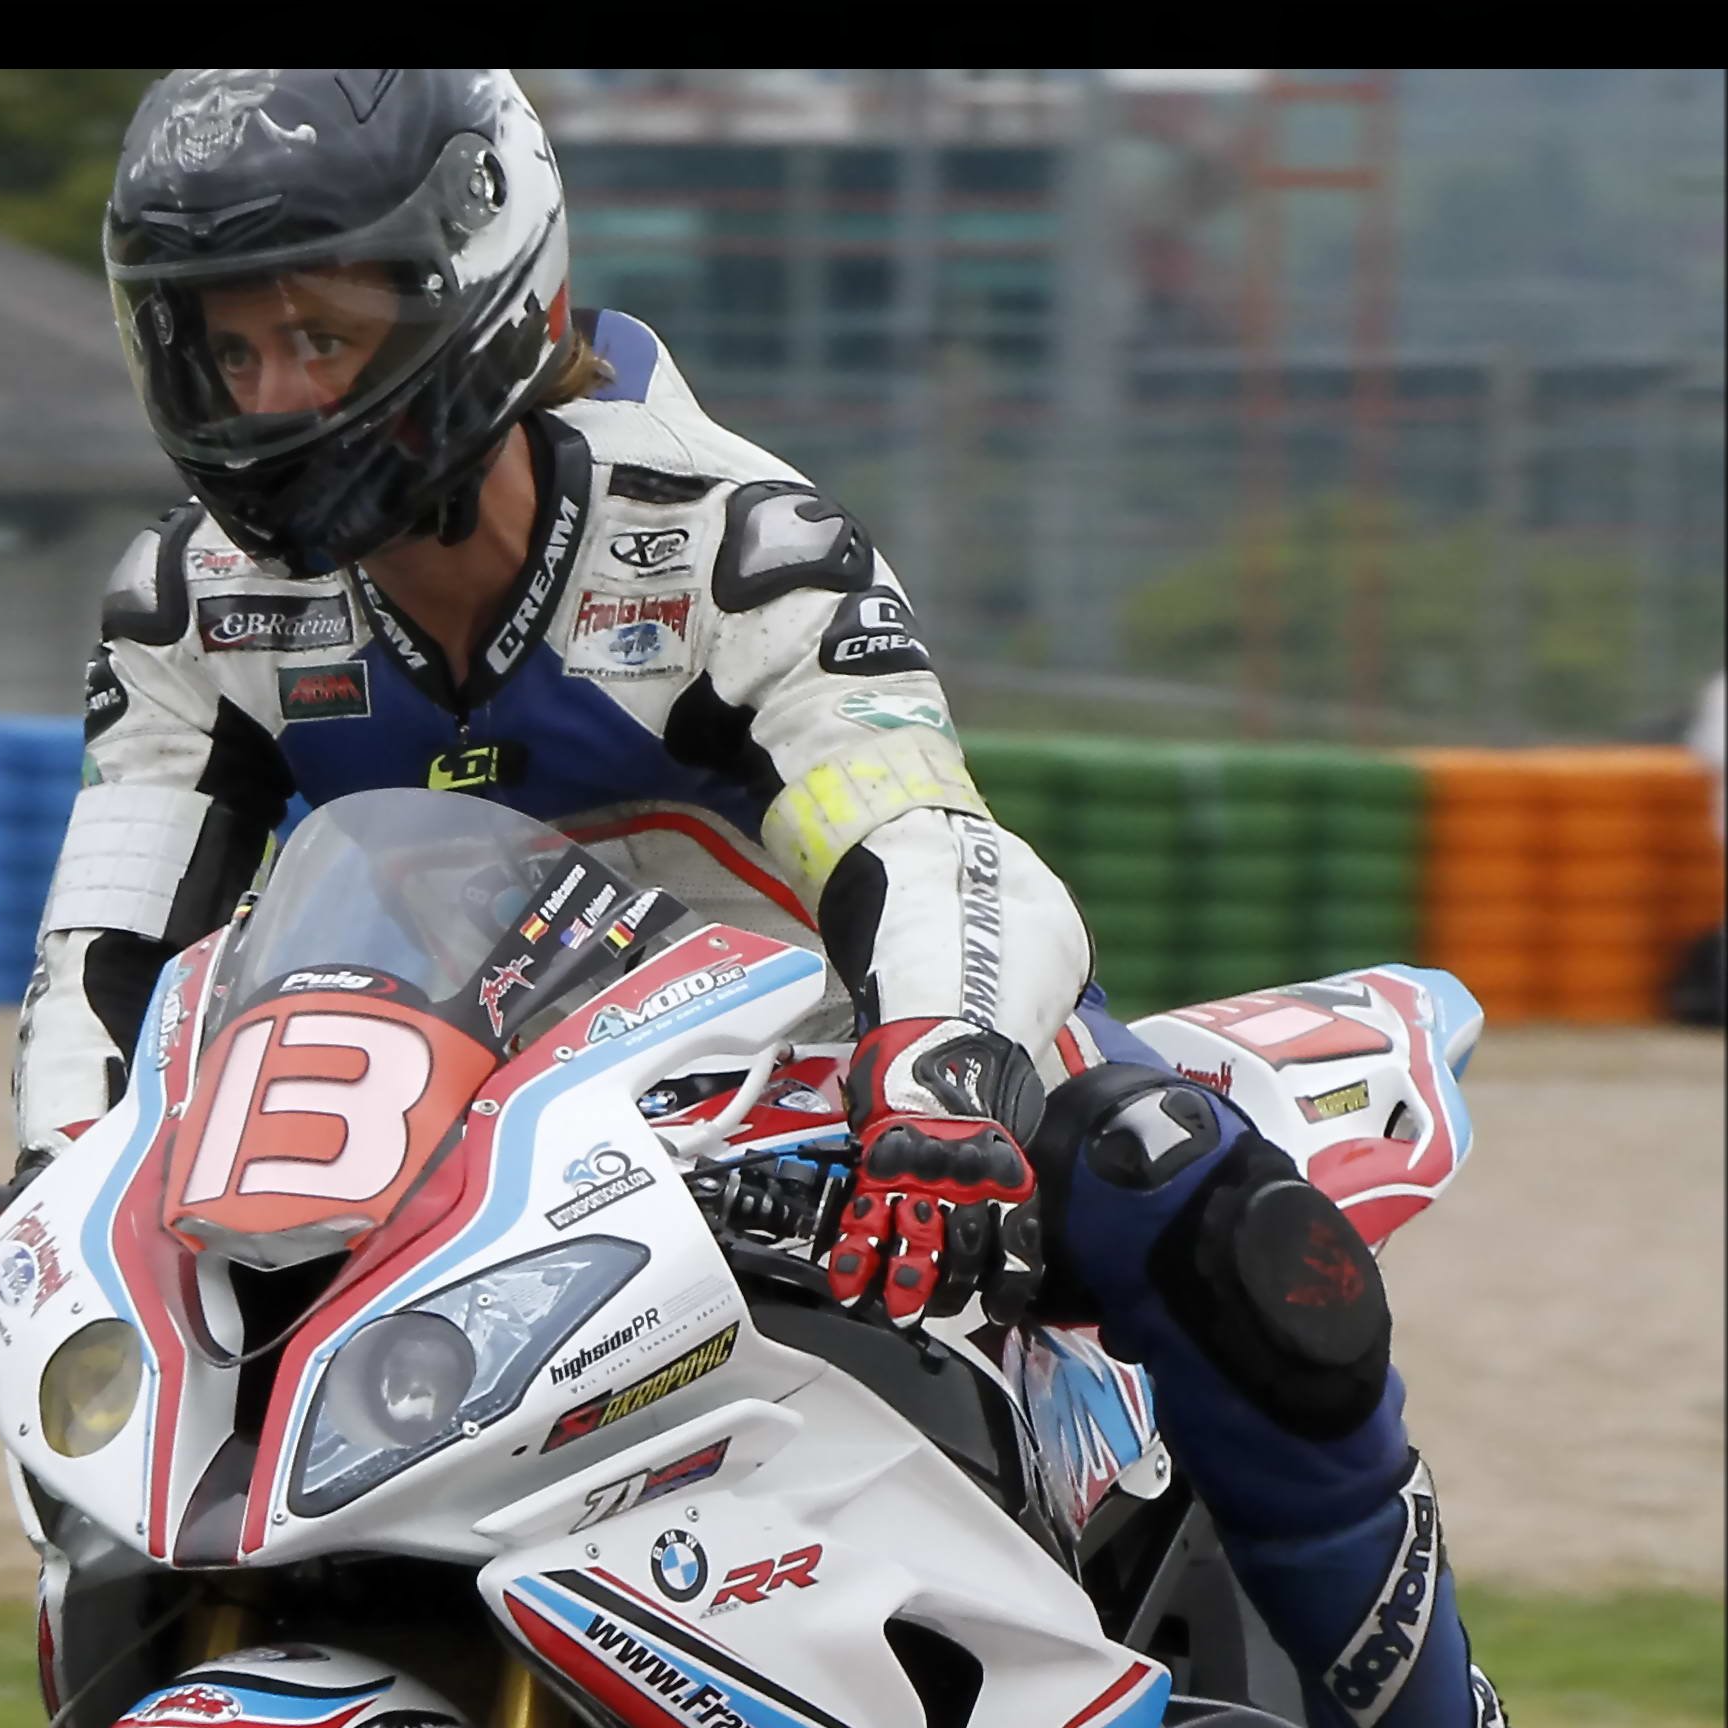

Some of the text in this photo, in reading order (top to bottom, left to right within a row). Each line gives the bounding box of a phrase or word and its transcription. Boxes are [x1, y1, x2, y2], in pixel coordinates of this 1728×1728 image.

[222, 612, 346, 639] GBRacing
[282, 970, 375, 990] Puig
[181, 1009, 434, 1204] 13
[550, 1307, 662, 1386] highsidePR
[710, 1543, 823, 1606] RR
